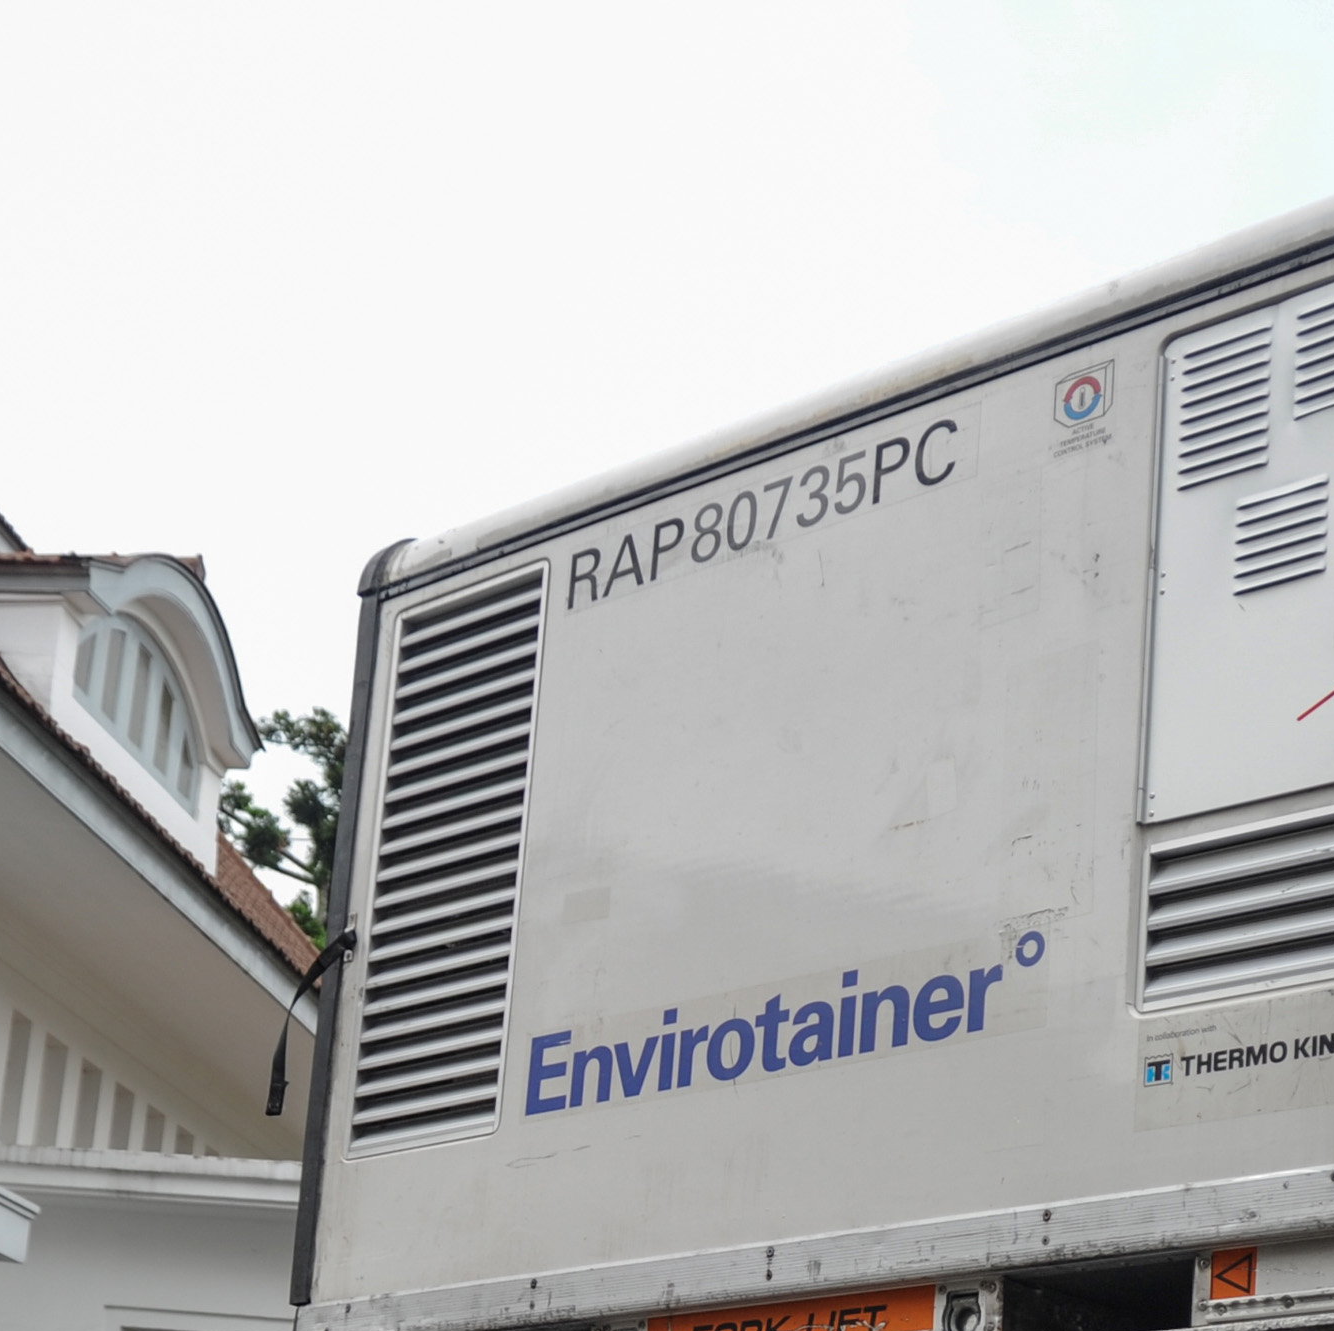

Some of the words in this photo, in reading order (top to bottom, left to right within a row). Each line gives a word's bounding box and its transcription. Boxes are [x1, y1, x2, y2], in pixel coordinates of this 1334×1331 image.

[1060, 427, 1106, 447] TEMPERATURE
[1072, 423, 1094, 435] ACTIVE
[1053, 443, 1083, 458] CONTROL
[1085, 433, 1112, 447] SYSTEM
[566, 420, 958, 610] RAP80735PC
[525, 964, 1002, 1116] Envirotainer
[1154, 1027, 1200, 1042] collaboration
[1201, 1025, 1217, 1034] with
[1181, 1041, 1288, 1076] THERMO
